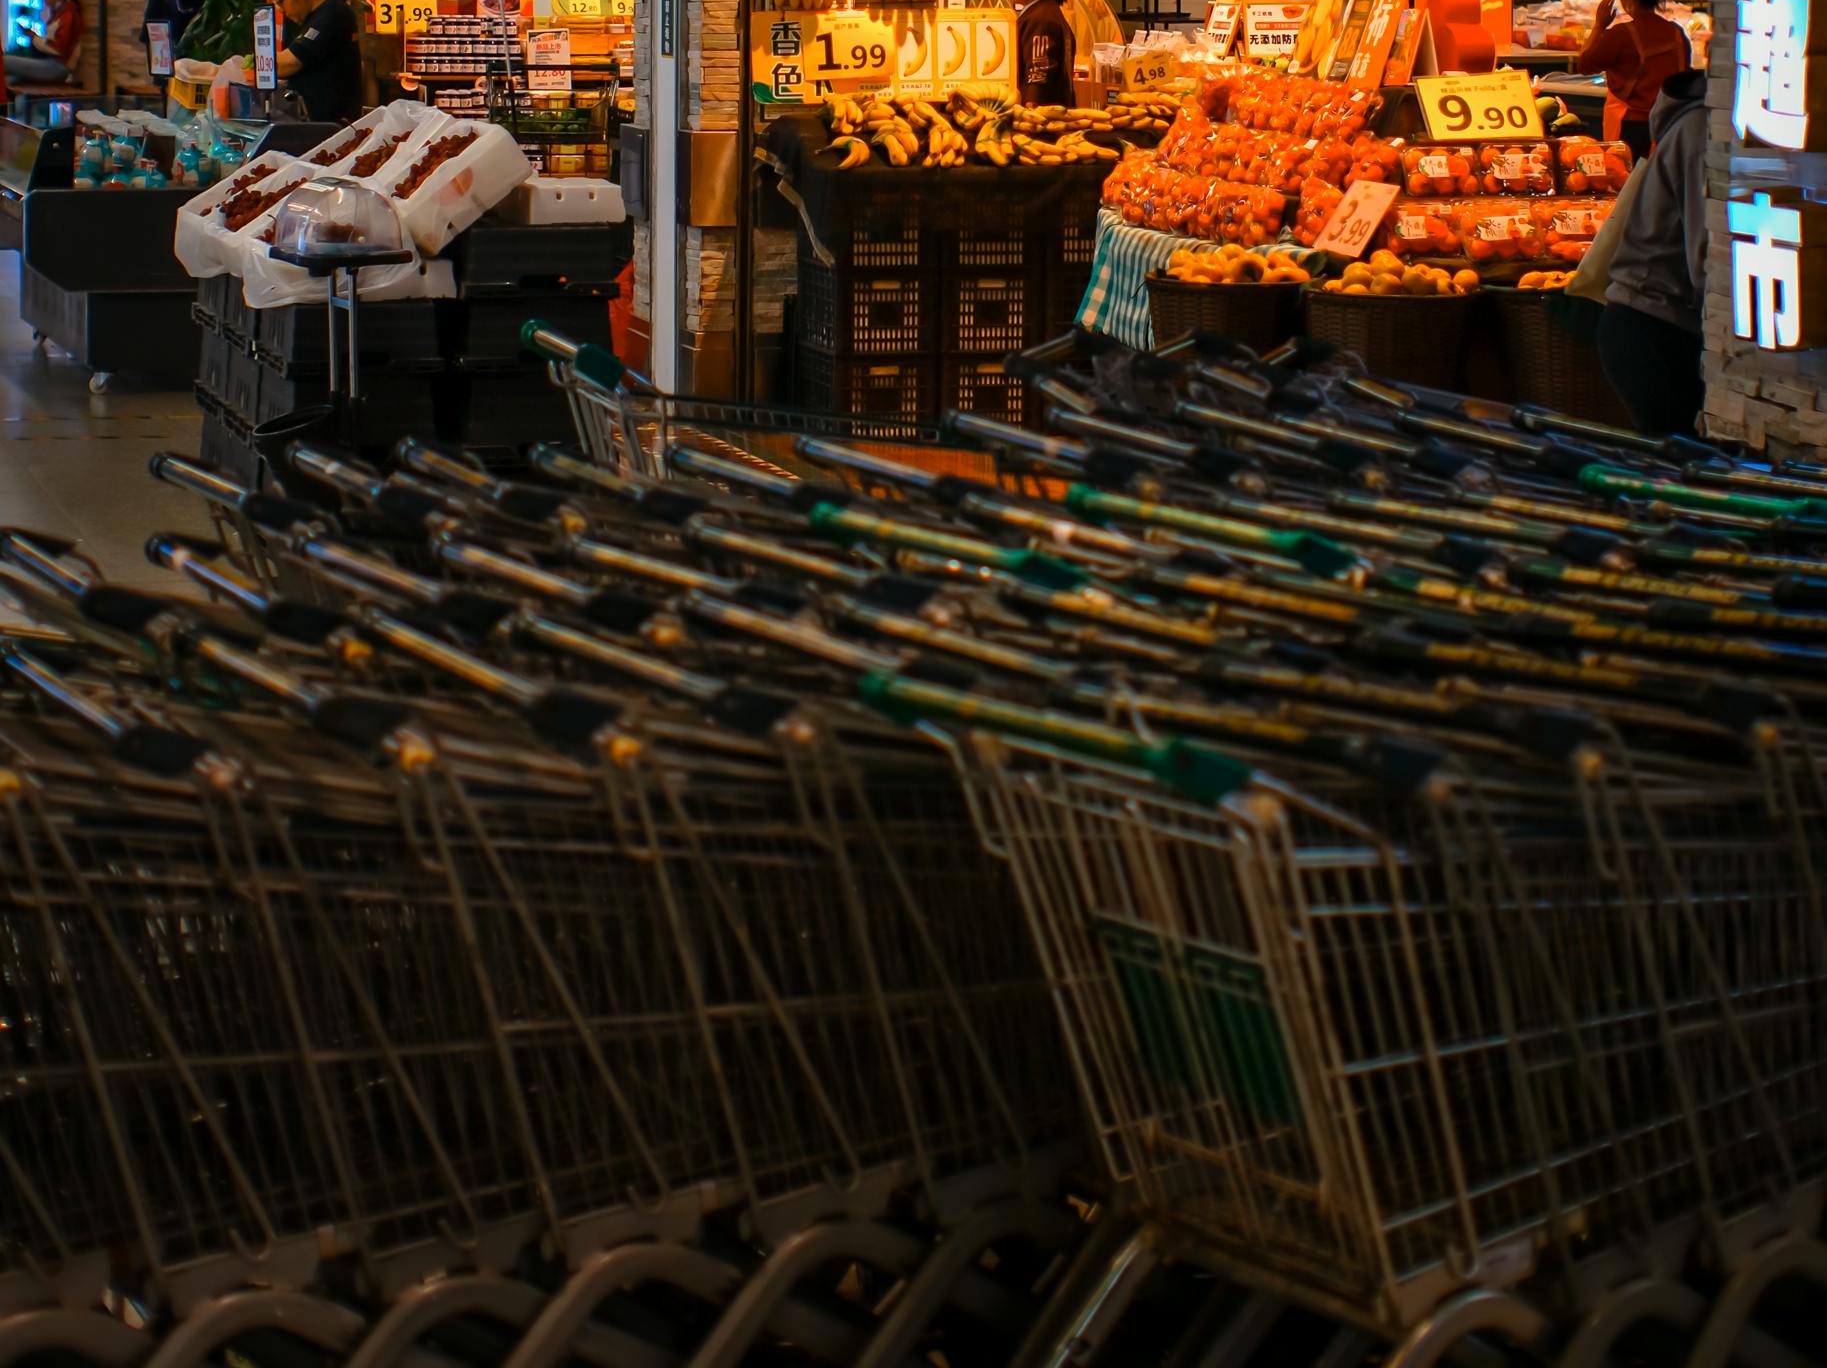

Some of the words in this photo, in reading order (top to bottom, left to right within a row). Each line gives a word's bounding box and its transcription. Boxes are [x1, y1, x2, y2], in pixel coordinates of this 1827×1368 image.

[379, 3, 433, 25] 3.99
[816, 31, 886, 72] 1.99
[1133, 66, 1166, 85] 4.98
[1437, 94, 1529, 132] 9.90
[1327, 199, 1372, 247] 3.99
